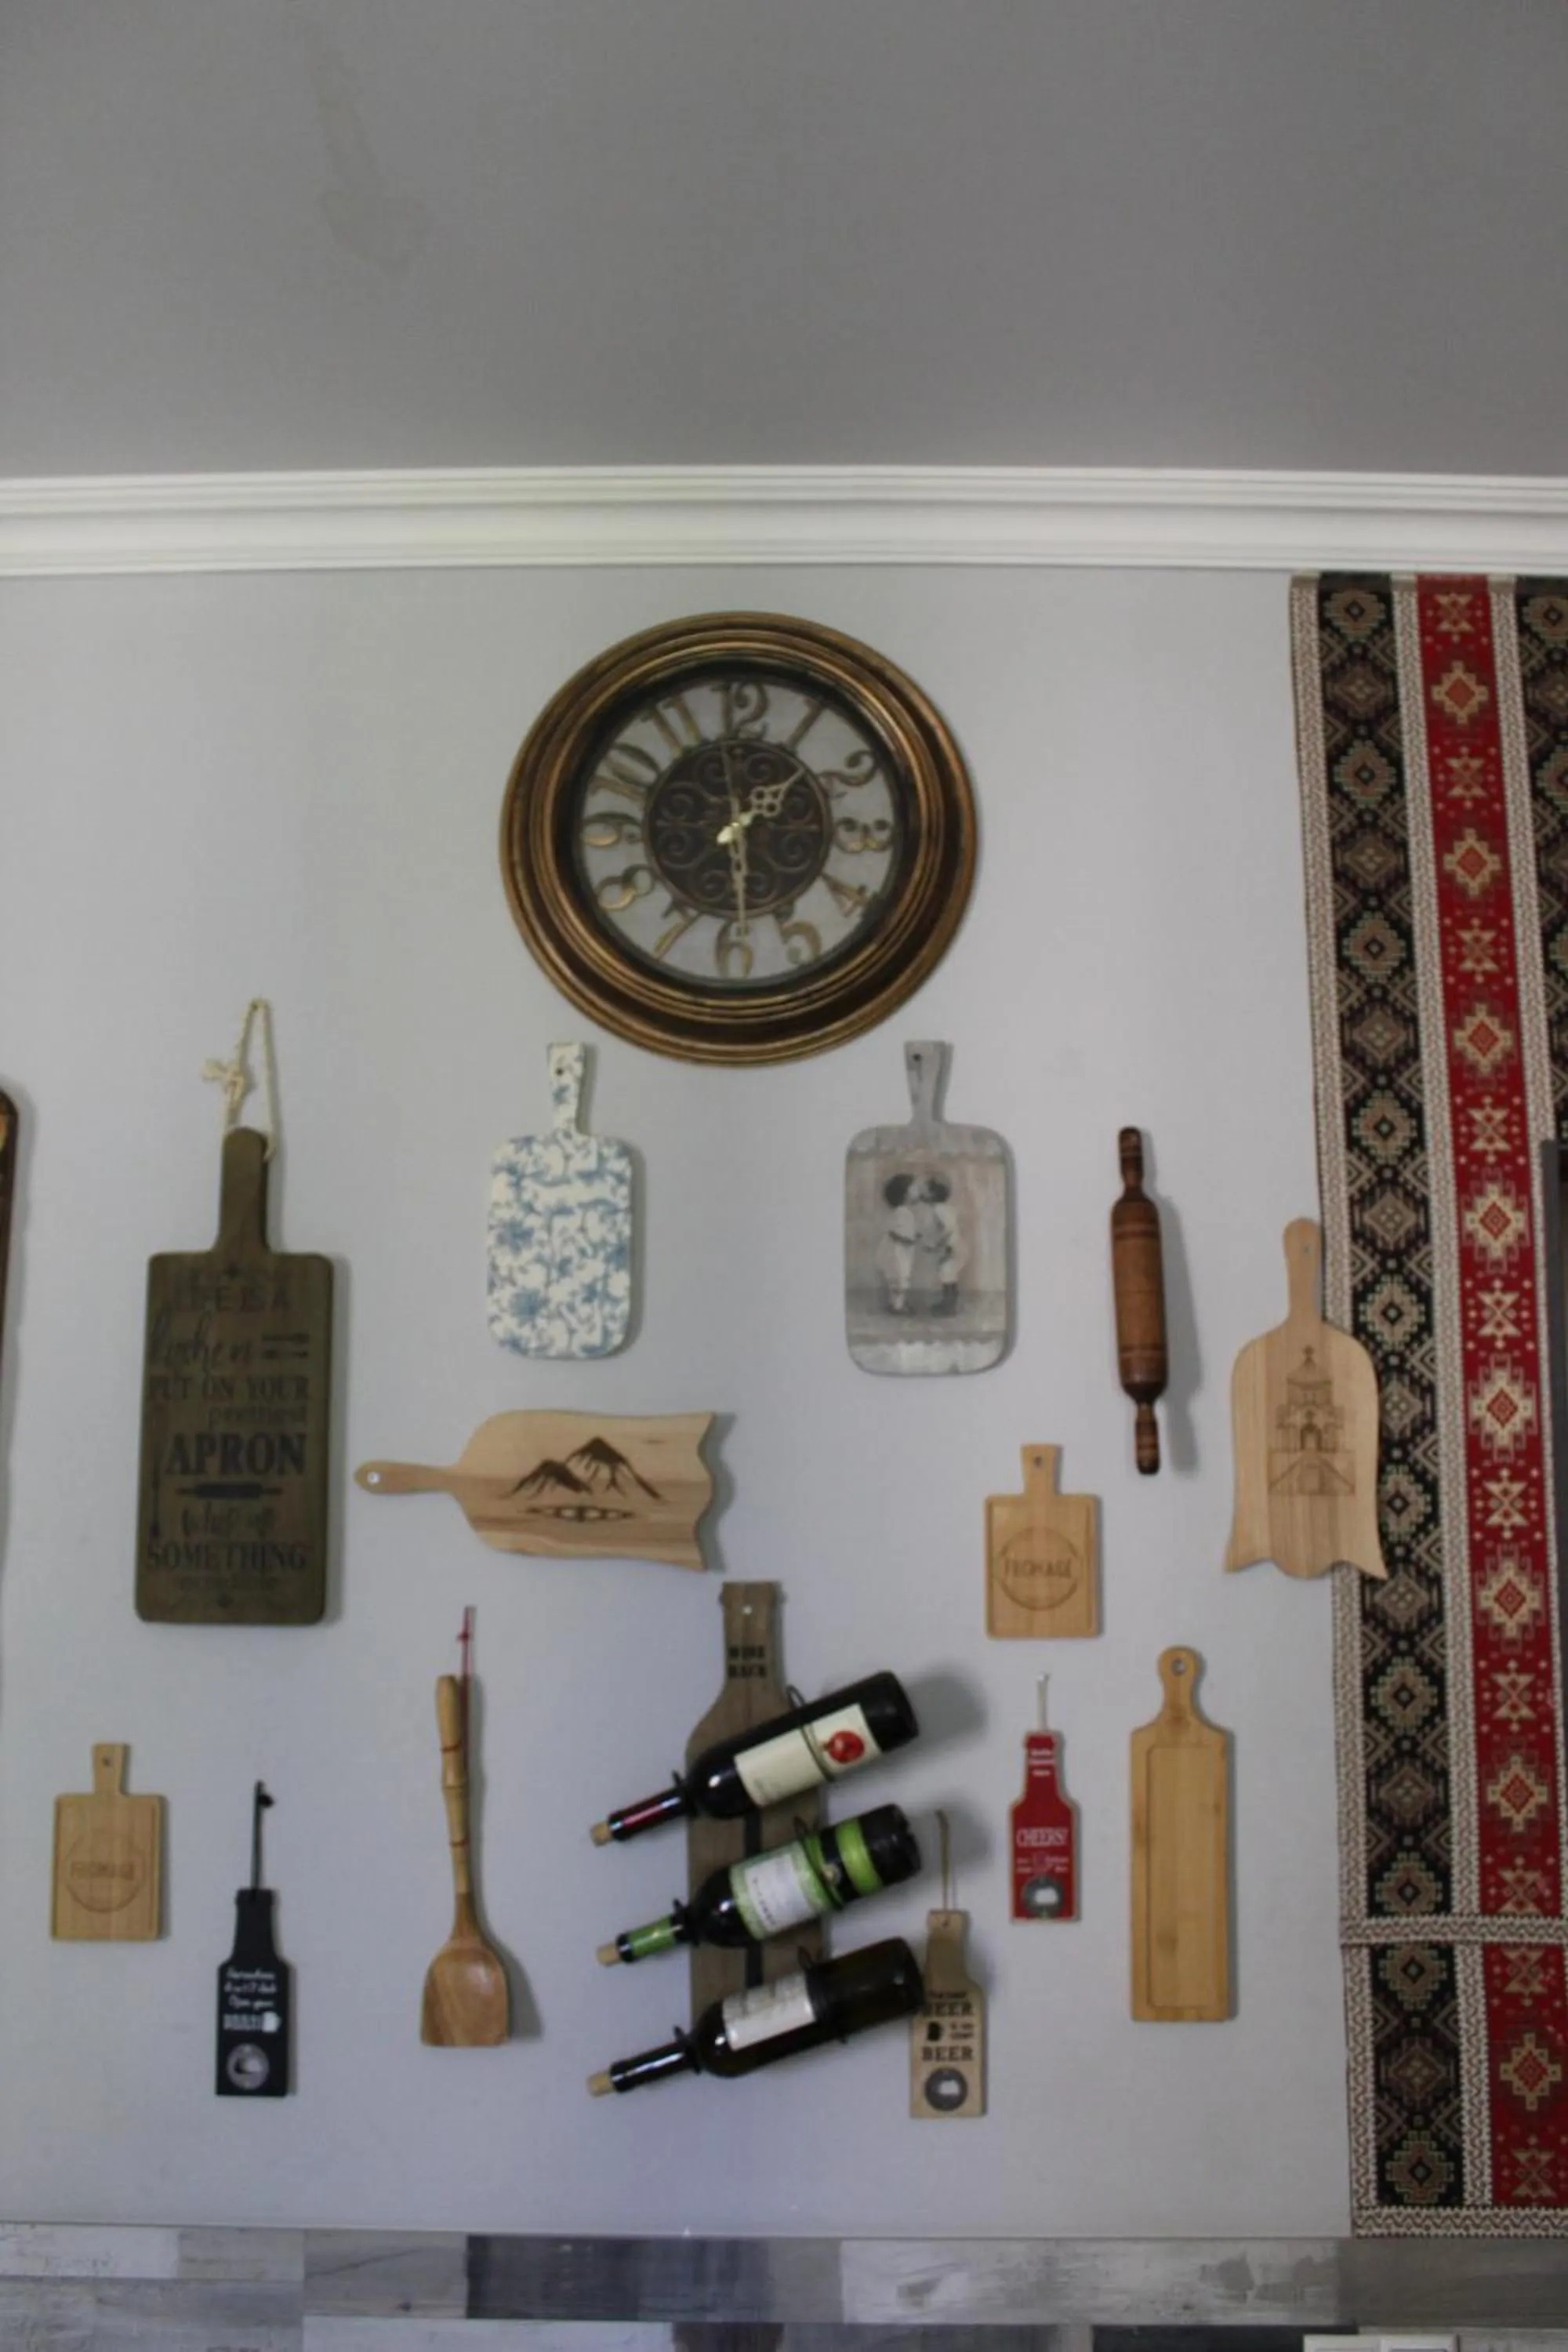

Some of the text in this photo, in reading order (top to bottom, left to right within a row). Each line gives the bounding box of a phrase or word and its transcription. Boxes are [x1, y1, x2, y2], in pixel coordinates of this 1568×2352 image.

[642, 697, 702, 753] 11
[712, 682, 770, 739] 12
[590, 742, 660, 801] 10
[818, 750, 877, 800] 2
[583, 814, 643, 848] 9
[835, 818, 891, 851] 3
[597, 864, 655, 910] 8
[822, 874, 878, 916] 4
[652, 901, 699, 959] 7
[714, 917, 753, 978] 6
[775, 905, 821, 965] 5
[202, 1375, 234, 1401] ON
[246, 1375, 310, 1402] YOUR
[164, 1433, 307, 1476] APRON
[146, 1541, 308, 1573] SOMETHING
[923, 2002, 972, 2017] BEER
[922, 2045, 973, 2062] BEER
